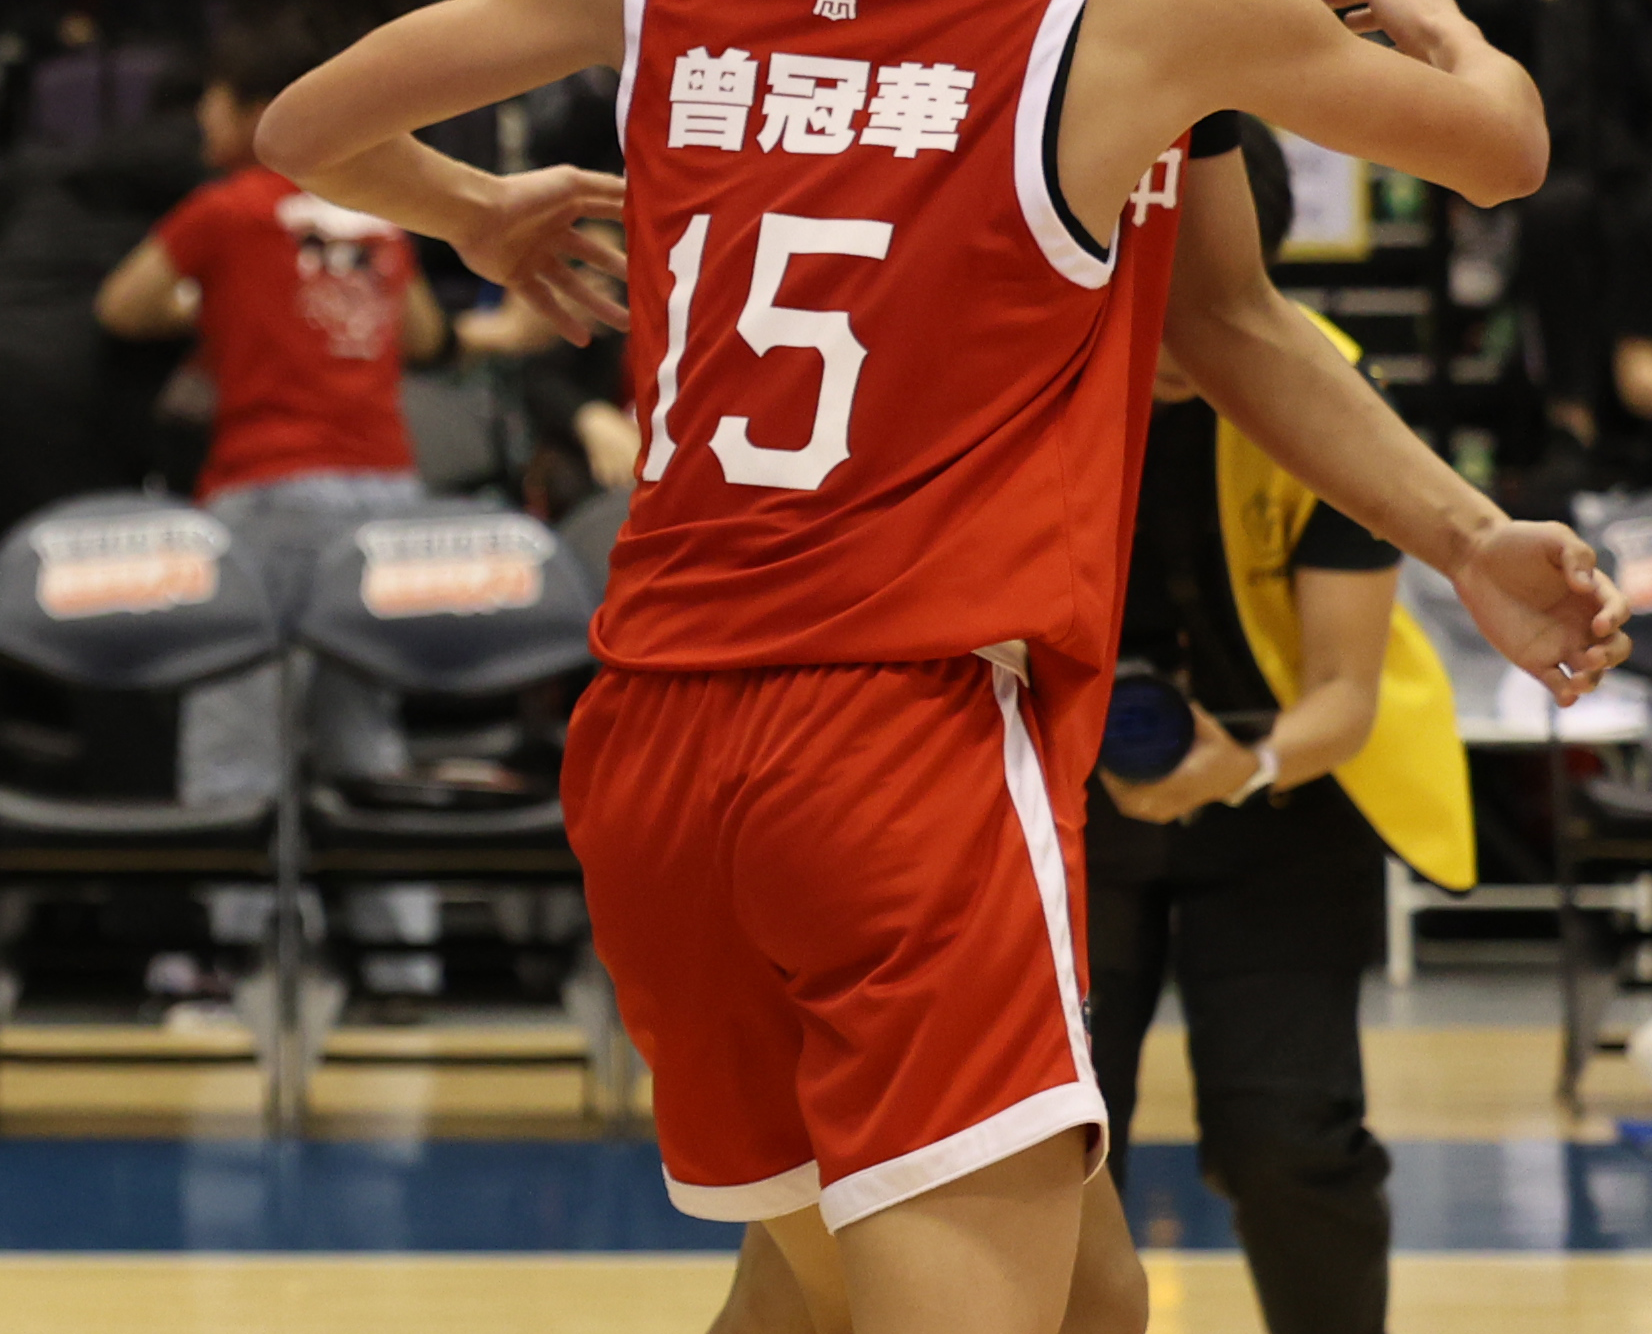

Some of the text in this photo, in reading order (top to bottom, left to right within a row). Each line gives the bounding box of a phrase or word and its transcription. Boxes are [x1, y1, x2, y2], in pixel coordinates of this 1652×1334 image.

[667, 46, 976, 159] 曾冠華
[642, 212, 895, 491] 15
